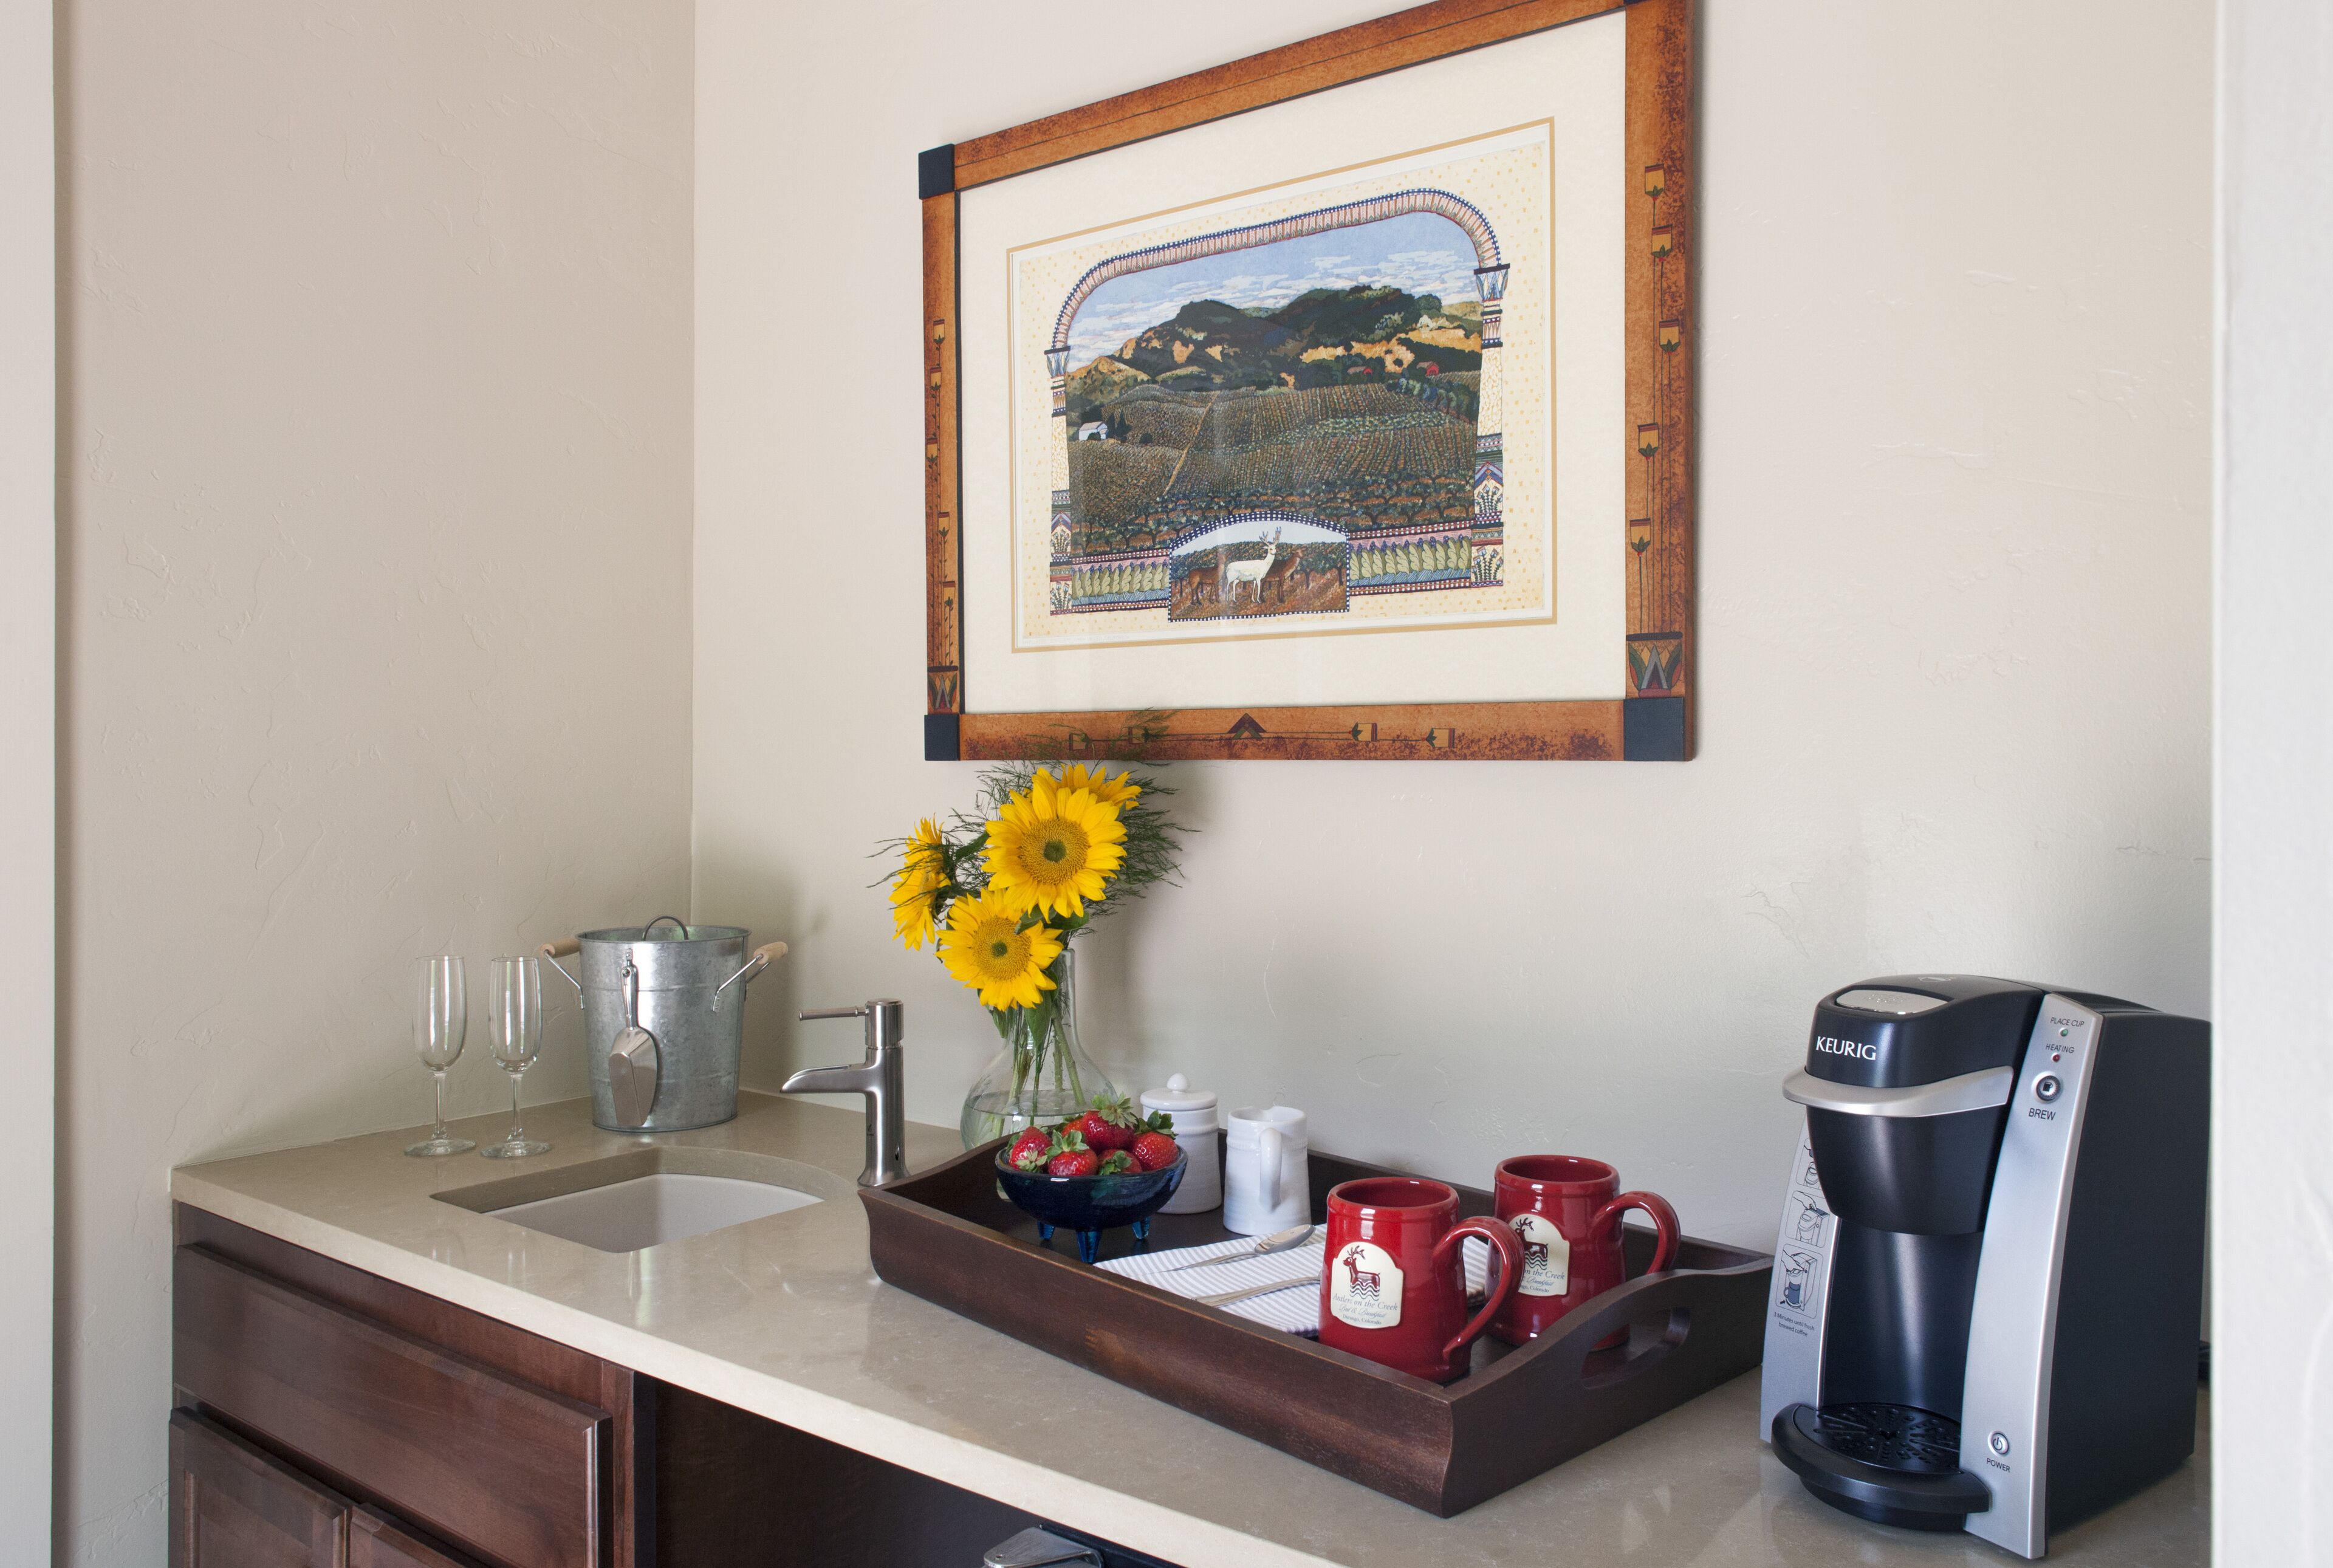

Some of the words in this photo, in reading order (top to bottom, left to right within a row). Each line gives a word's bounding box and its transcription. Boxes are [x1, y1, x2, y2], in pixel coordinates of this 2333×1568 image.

[2050, 1017, 2071, 1026] PLACE
[1815, 1036, 1877, 1061] KEURIG
[2045, 1044, 2075, 1053] HEATING
[2028, 1108, 2057, 1121] BREW
[1532, 1268, 1543, 1277] the
[1545, 1270, 1565, 1280] Creek
[1333, 1293, 1352, 1304] Antlers
[1364, 1299, 1375, 1308] the
[1377, 1301, 1399, 1311] Creek
[1361, 1316, 1382, 1326] Colorado
[1777, 1313, 1793, 1323] Minutes
[1778, 1321, 1795, 1332] brewed
[1795, 1329, 1809, 1337] coffee
[1987, 1457, 2010, 1473] POWER
